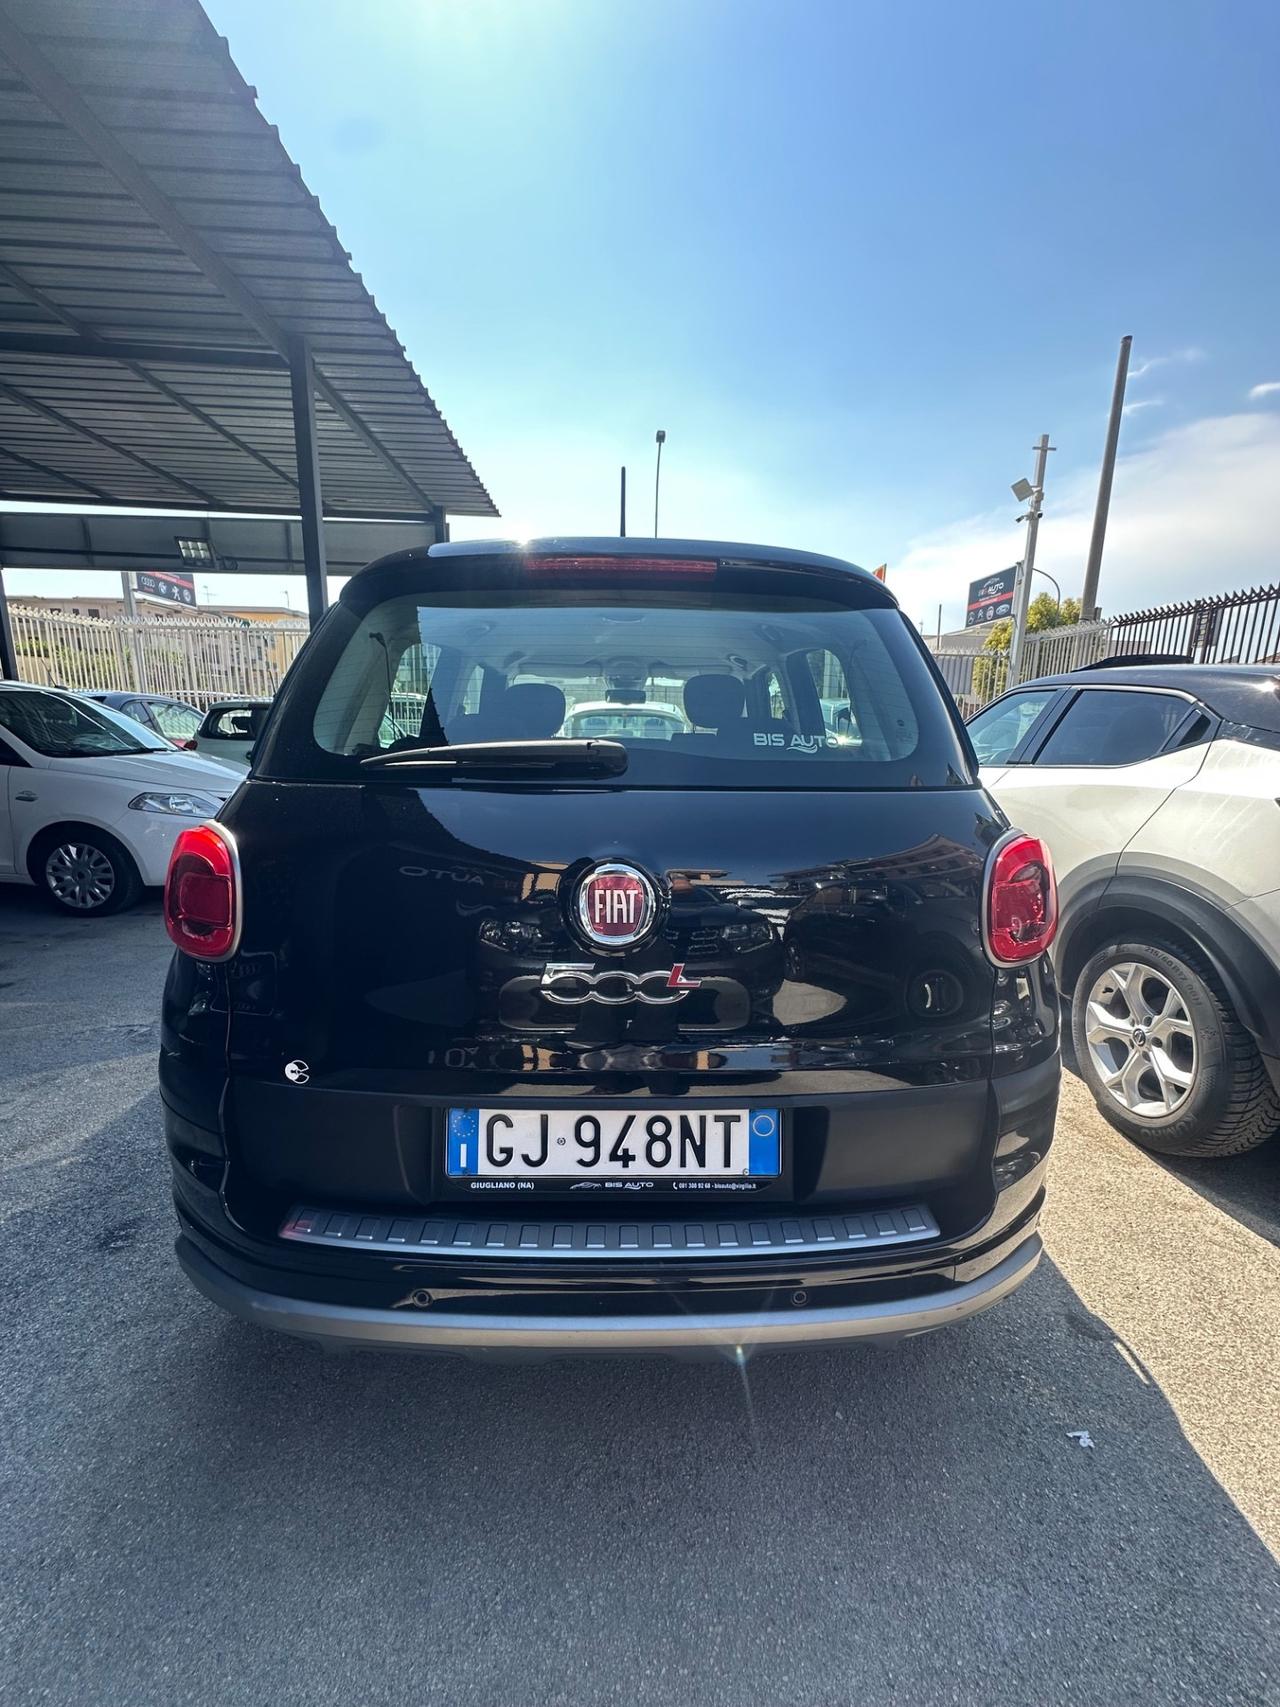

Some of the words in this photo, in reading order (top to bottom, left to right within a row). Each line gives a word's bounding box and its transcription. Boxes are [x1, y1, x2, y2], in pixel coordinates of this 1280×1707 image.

[753, 733, 785, 747] BIS
[790, 734, 839, 749] AUTO
[593, 889, 639, 924] FIAT
[540, 962, 702, 1006] 500L
[485, 1113, 549, 1169] GJ
[573, 1114, 742, 1169] 948NT
[470, 1181, 516, 1190] GIUGLIANO
[517, 1181, 535, 1190] (NA)
[624, 1181, 654, 1190] AUTO
